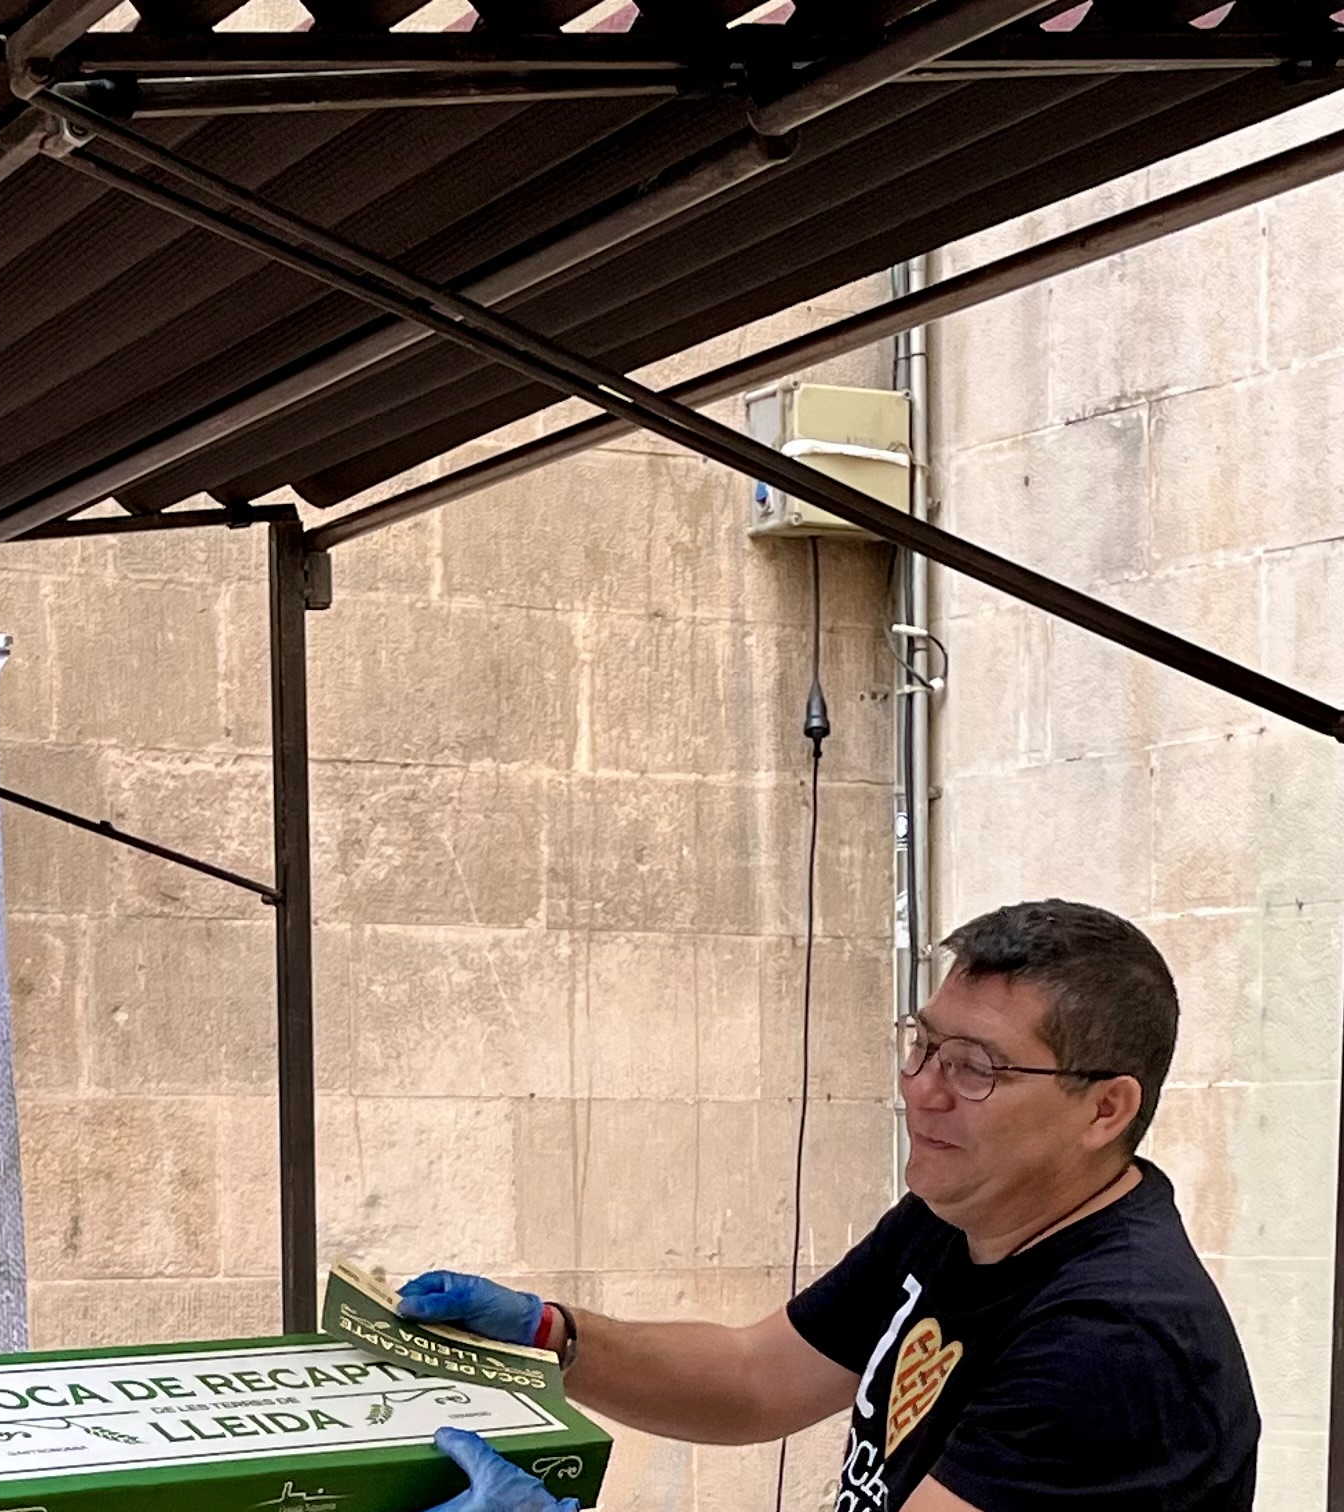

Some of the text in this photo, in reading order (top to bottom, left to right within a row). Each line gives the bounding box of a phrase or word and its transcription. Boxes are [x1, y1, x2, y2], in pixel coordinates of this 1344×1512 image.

[339, 1315, 546, 1389] COCA DE RECAPTE
[399, 1328, 480, 1363] LLEIDA
[110, 1376, 198, 1401] DE
[151, 1407, 176, 1415] DE
[176, 1404, 210, 1413] LES
[275, 1397, 301, 1406] DE
[148, 1409, 353, 1443] LLEIDA
